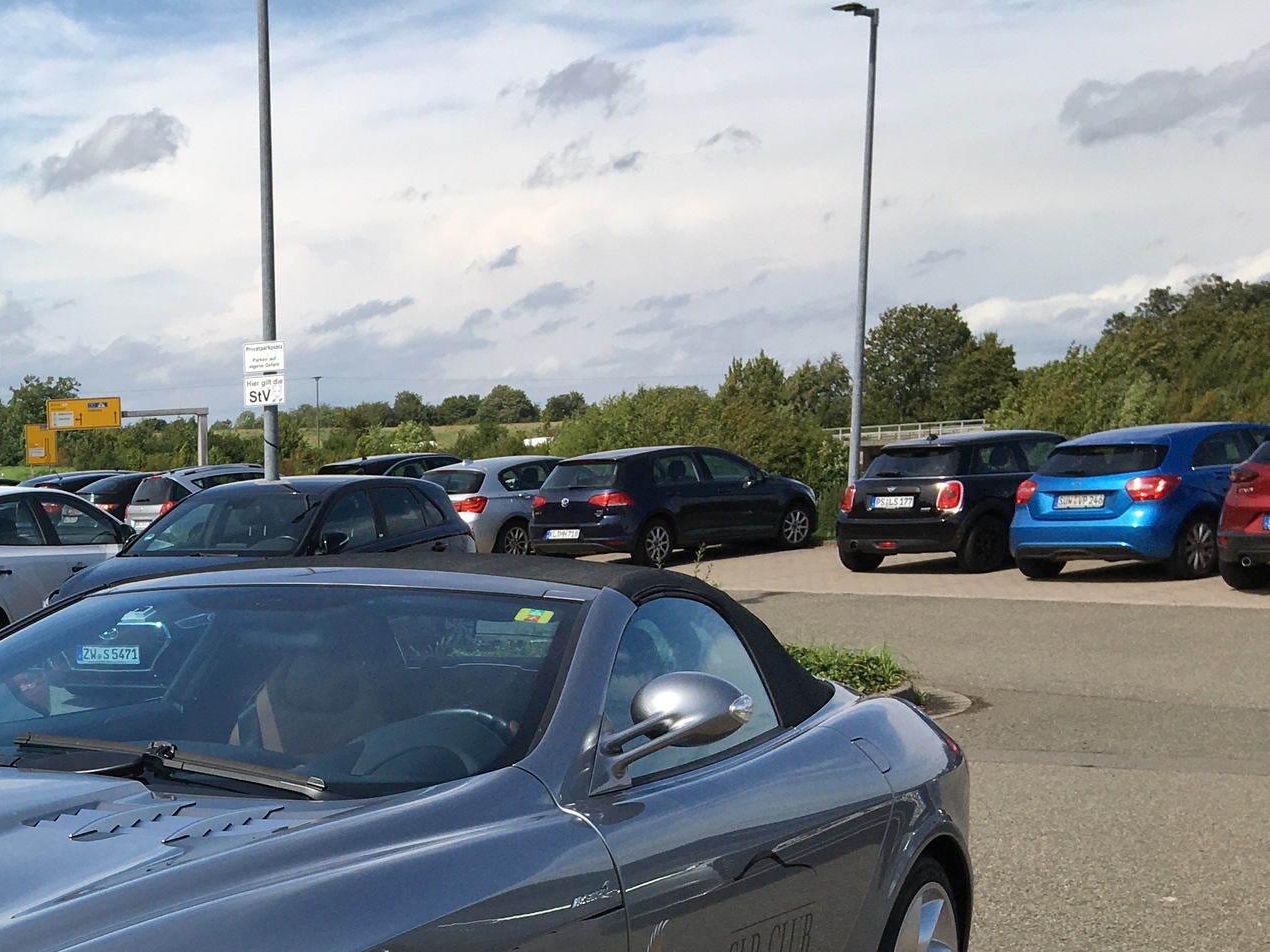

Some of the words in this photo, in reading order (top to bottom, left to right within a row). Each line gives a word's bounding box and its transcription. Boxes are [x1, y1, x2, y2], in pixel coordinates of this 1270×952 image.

[246, 344, 283, 352] Privatparkplatz
[261, 379, 272, 387] gilt
[111, 648, 138, 660] 5471
